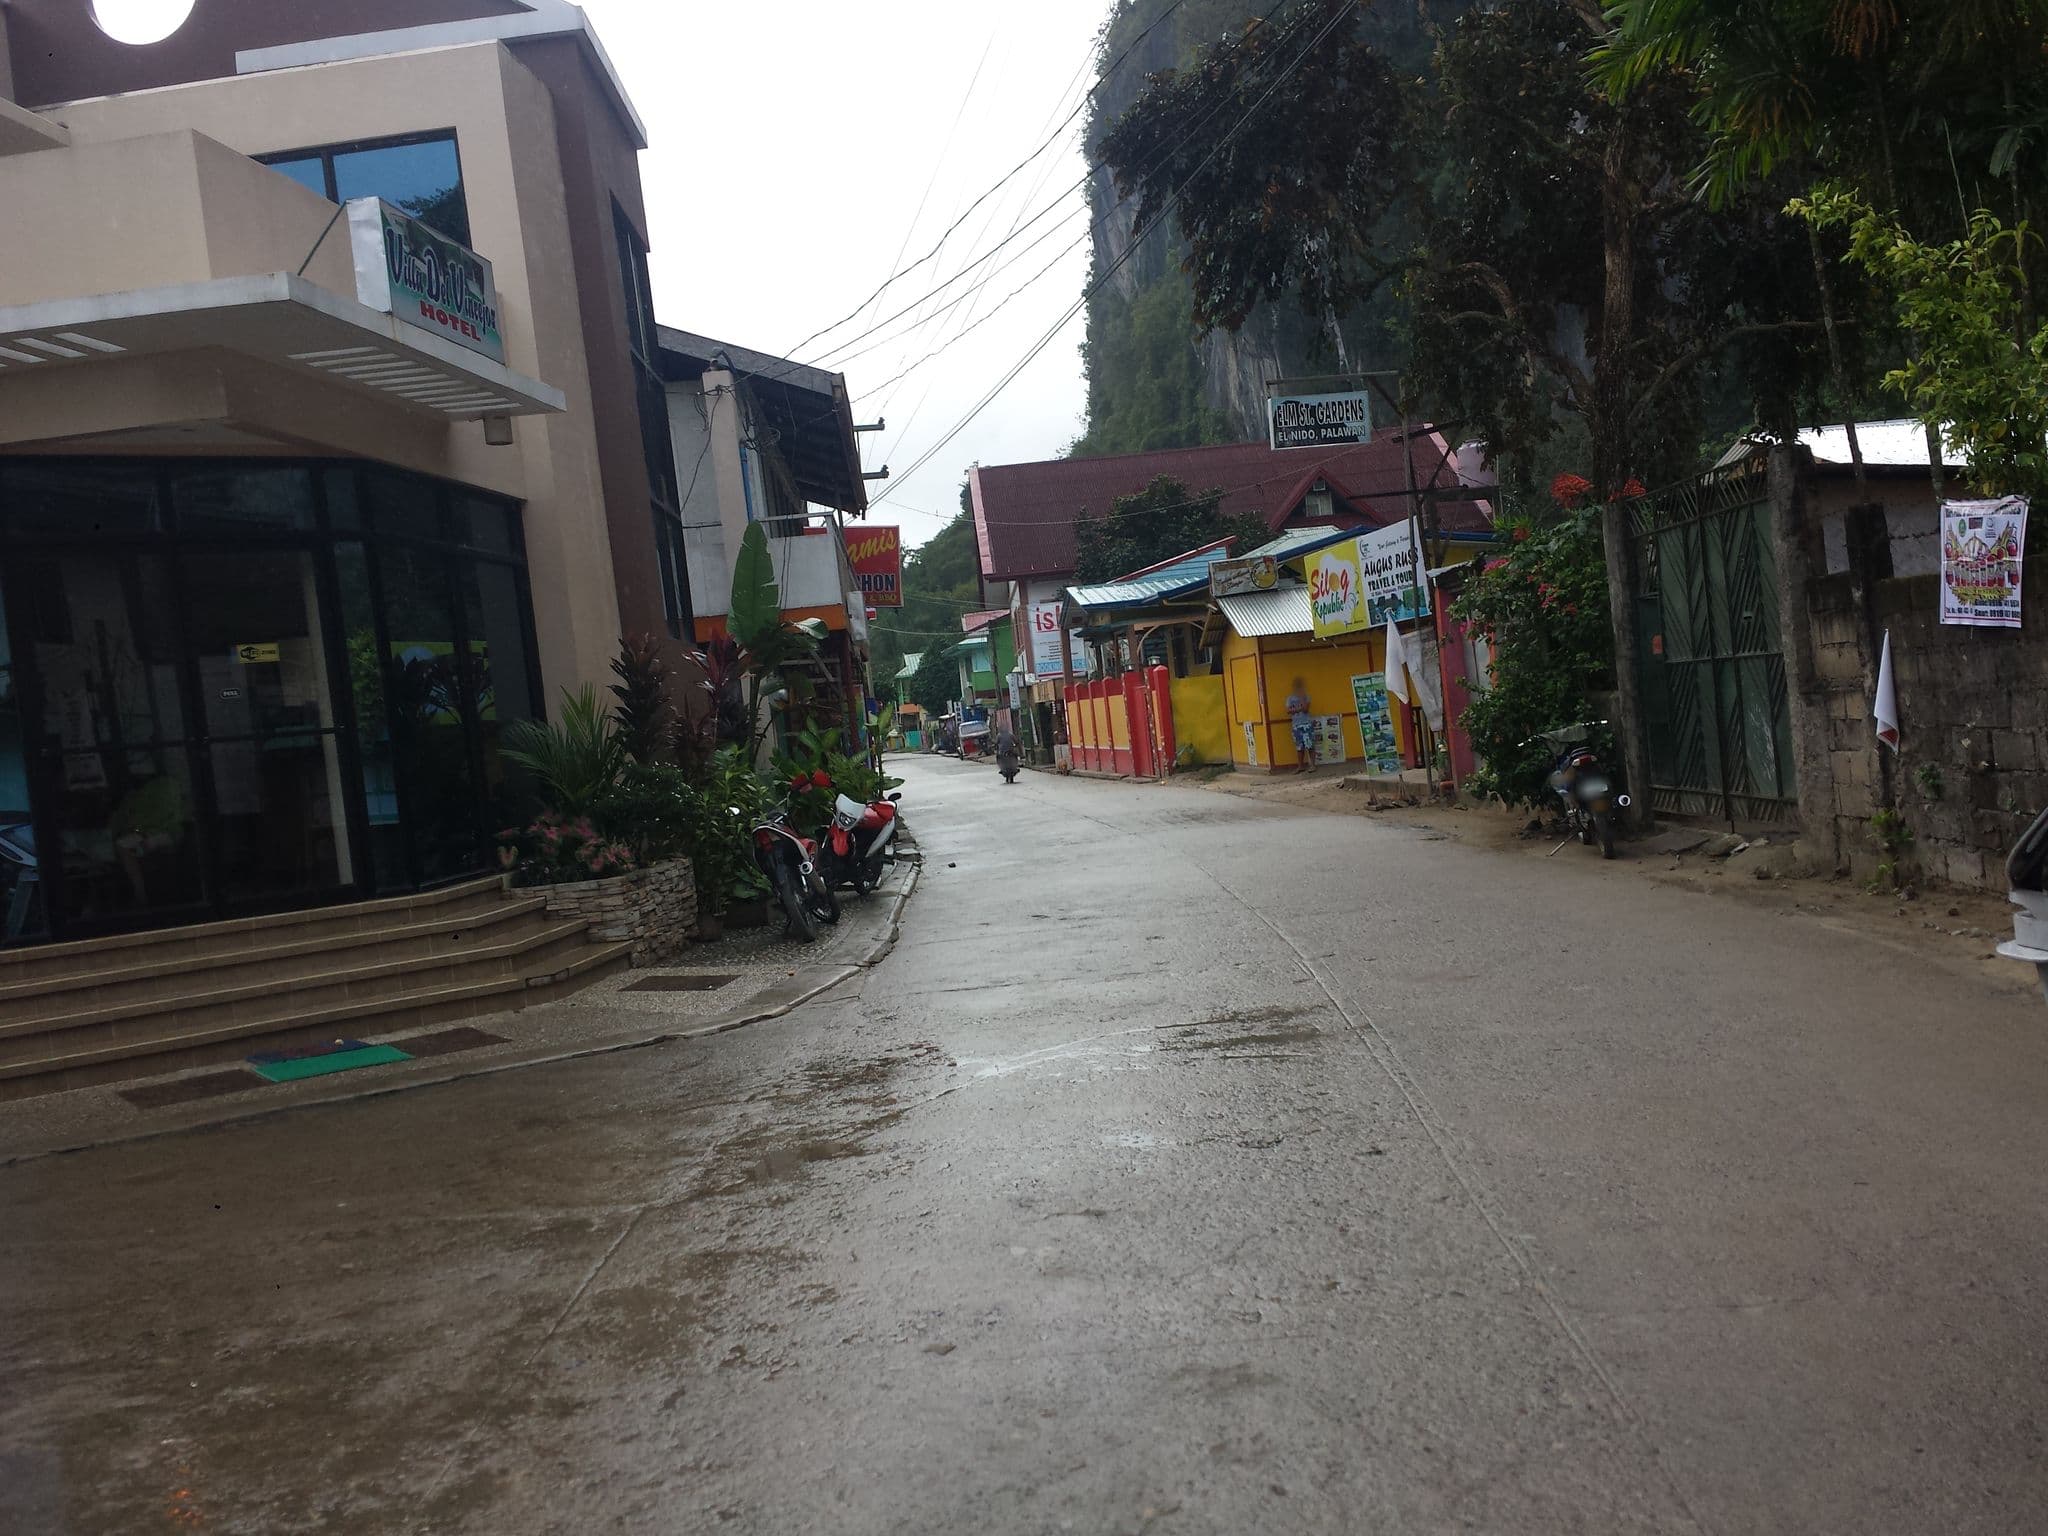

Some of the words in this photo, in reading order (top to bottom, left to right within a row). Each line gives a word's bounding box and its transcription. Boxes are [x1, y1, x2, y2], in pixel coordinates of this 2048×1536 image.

[386, 227, 425, 294] Villa
[424, 248, 450, 307] Del
[420, 300, 481, 342] HOTEL
[1277, 403, 1298, 428] ELM
[1299, 402, 1315, 427] ST.
[1316, 399, 1364, 425] GARDENS
[1278, 431, 1289, 441] EL
[1291, 429, 1319, 441] NIDO,
[1321, 425, 1365, 439] PALAWAN
[1363, 554, 1394, 578] AUGUS
[857, 573, 895, 592] HON
[1310, 567, 1350, 604] Silog
[1368, 575, 1391, 592] TRAVEL
[1396, 569, 1412, 584] TOUR
[1036, 604, 1061, 631] isl
[1313, 592, 1345, 625] Republic
